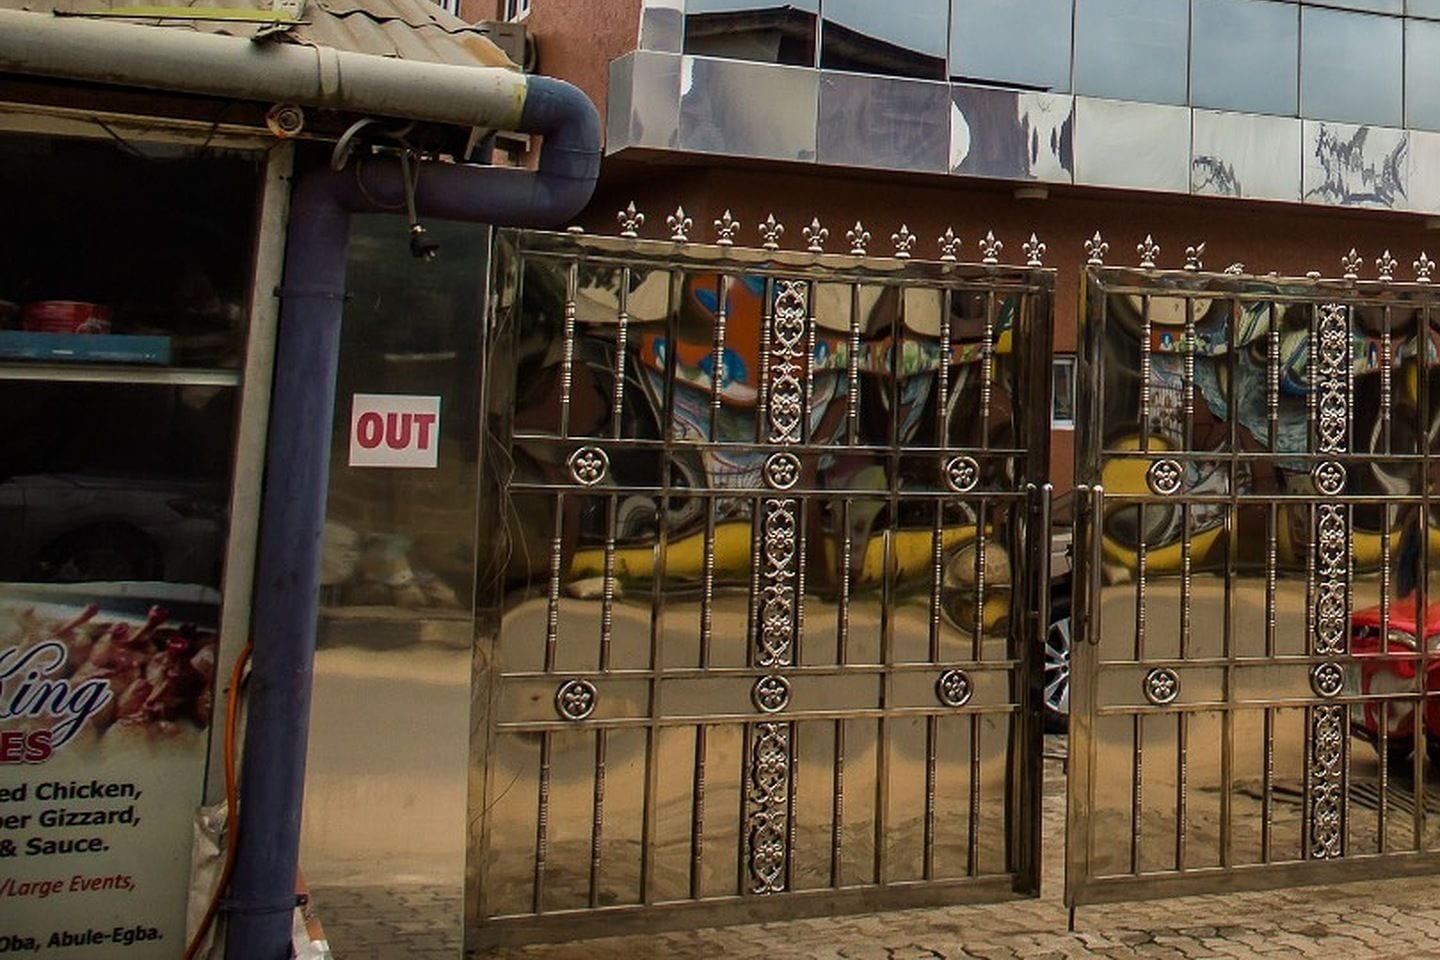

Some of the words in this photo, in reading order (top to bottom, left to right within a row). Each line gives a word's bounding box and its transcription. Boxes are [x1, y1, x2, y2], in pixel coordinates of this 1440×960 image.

[357, 411, 436, 450] OUT
[35, 780, 143, 800] Chicken,
[0, 814, 32, 830] er
[40, 805, 141, 828] Gizzard,
[25, 837, 110, 856] Sauce.
[69, 874, 136, 892] Events,
[47, 925, 163, 949] Abule-Egba.
